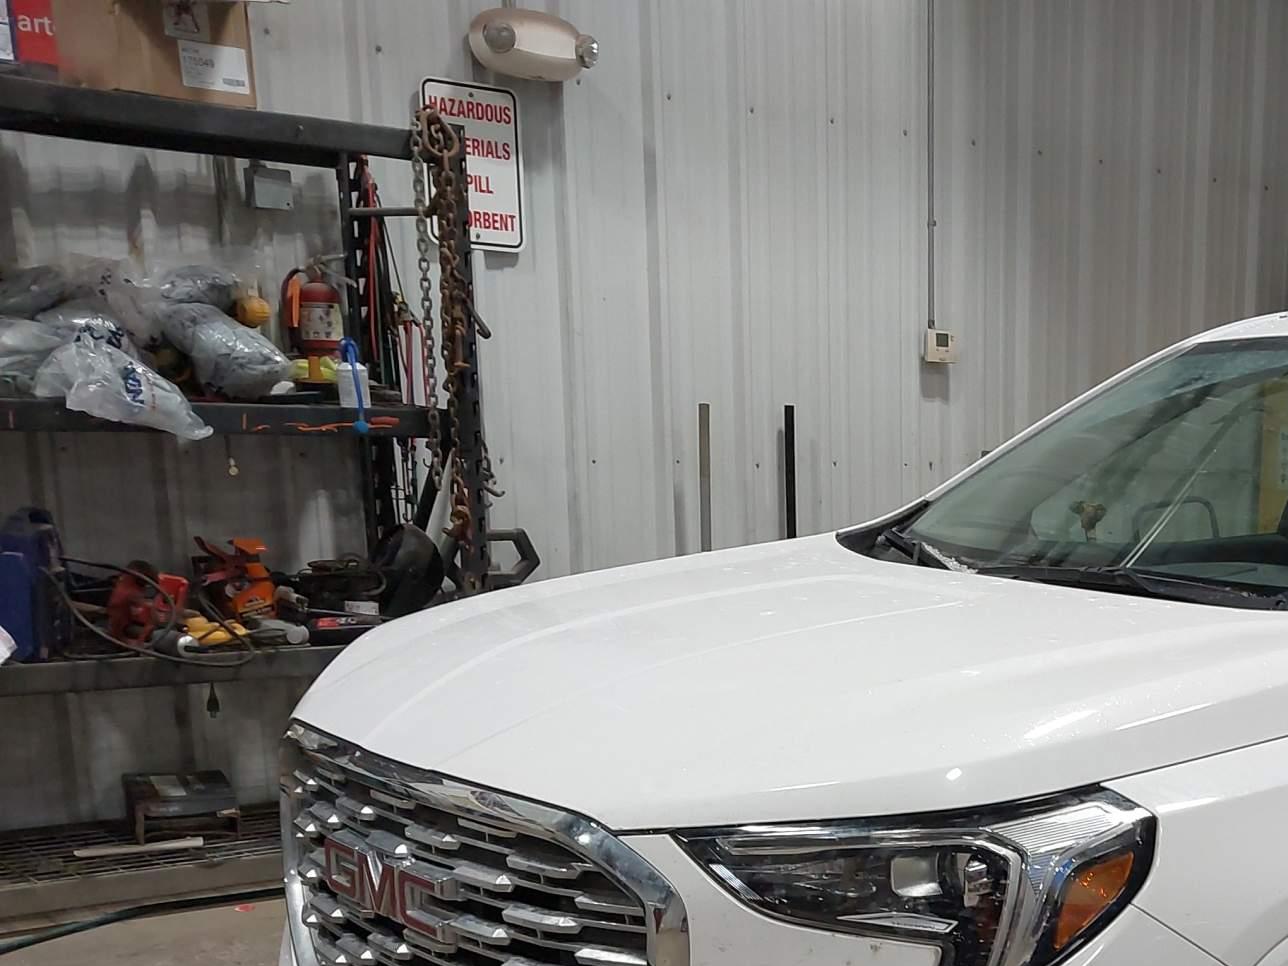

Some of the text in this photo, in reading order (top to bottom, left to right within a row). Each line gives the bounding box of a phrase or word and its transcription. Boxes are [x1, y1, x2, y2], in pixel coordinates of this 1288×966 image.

[428, 95, 512, 124] HAZARDOUS
[464, 137, 511, 160] ERIALS
[466, 174, 494, 194] PILL
[323, 836, 457, 944] GMC
